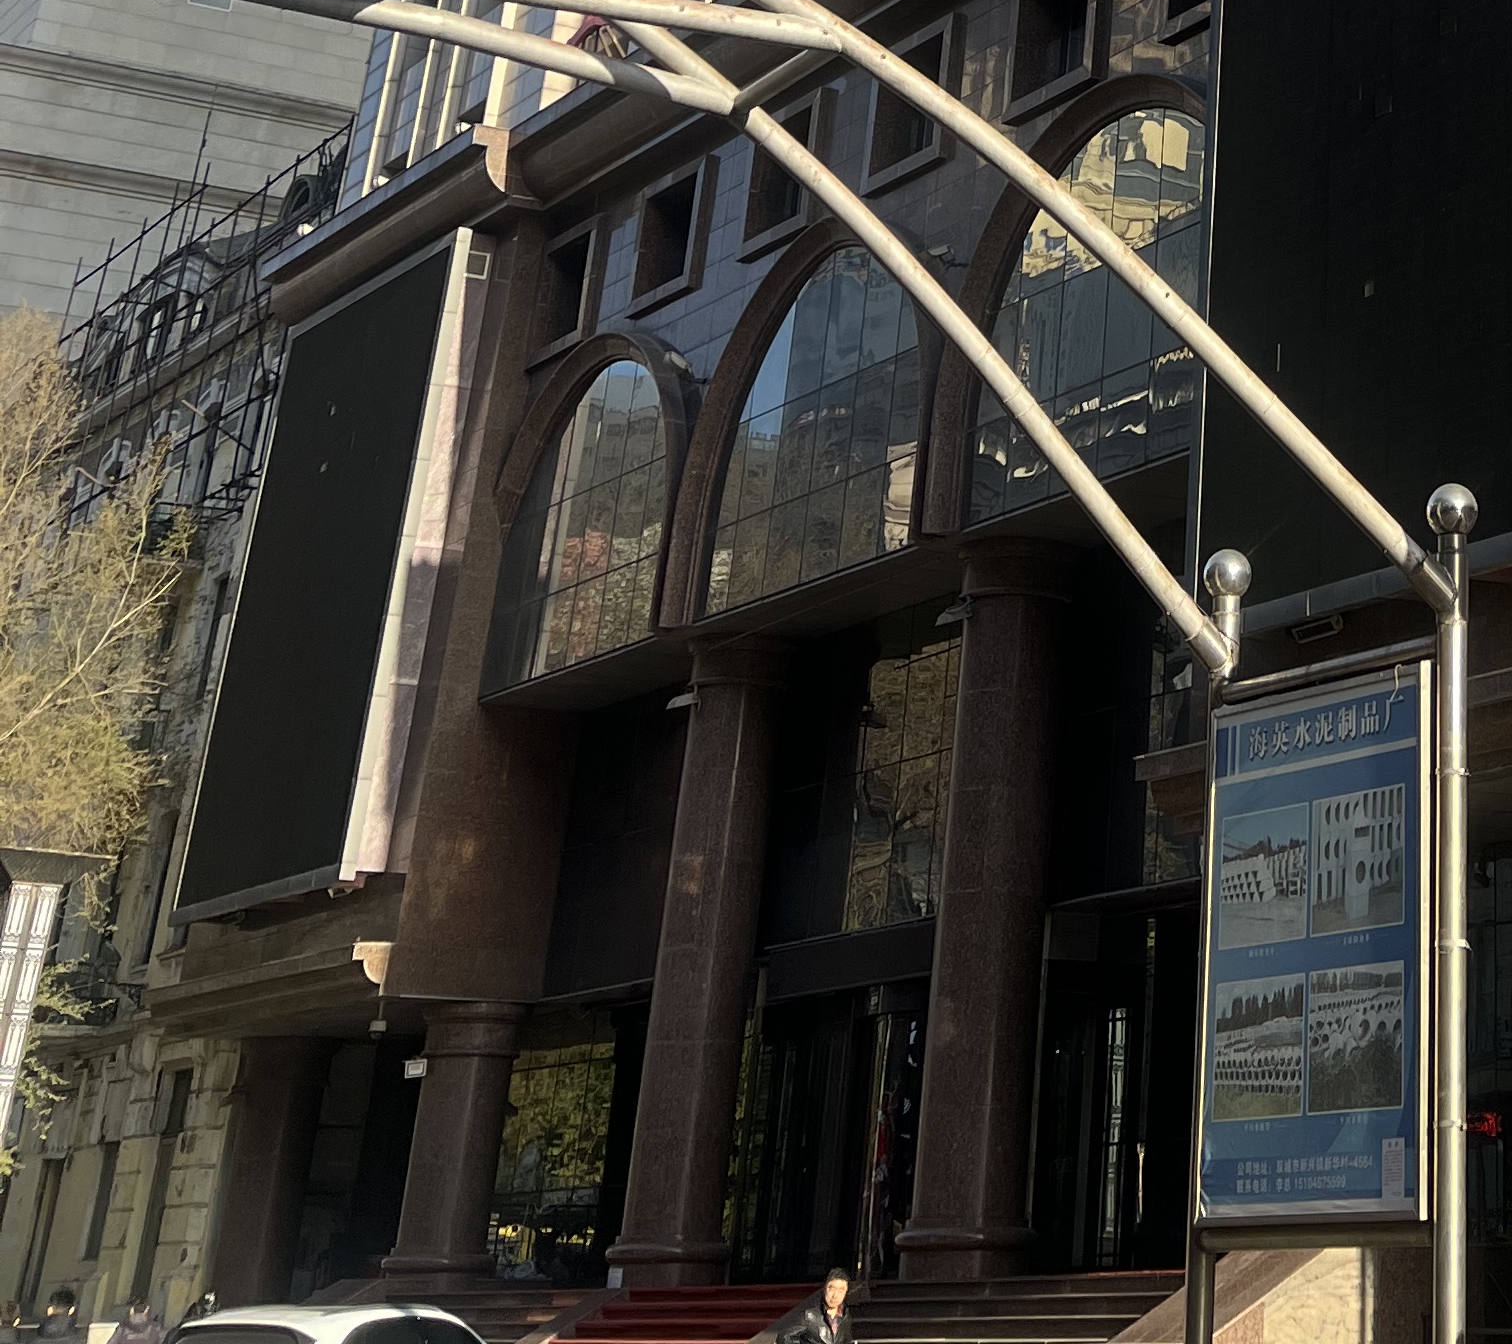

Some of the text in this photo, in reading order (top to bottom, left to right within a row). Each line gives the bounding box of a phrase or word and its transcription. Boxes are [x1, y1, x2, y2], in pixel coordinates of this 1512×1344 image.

[1248, 694, 1405, 760] 海英水泥制品厂
